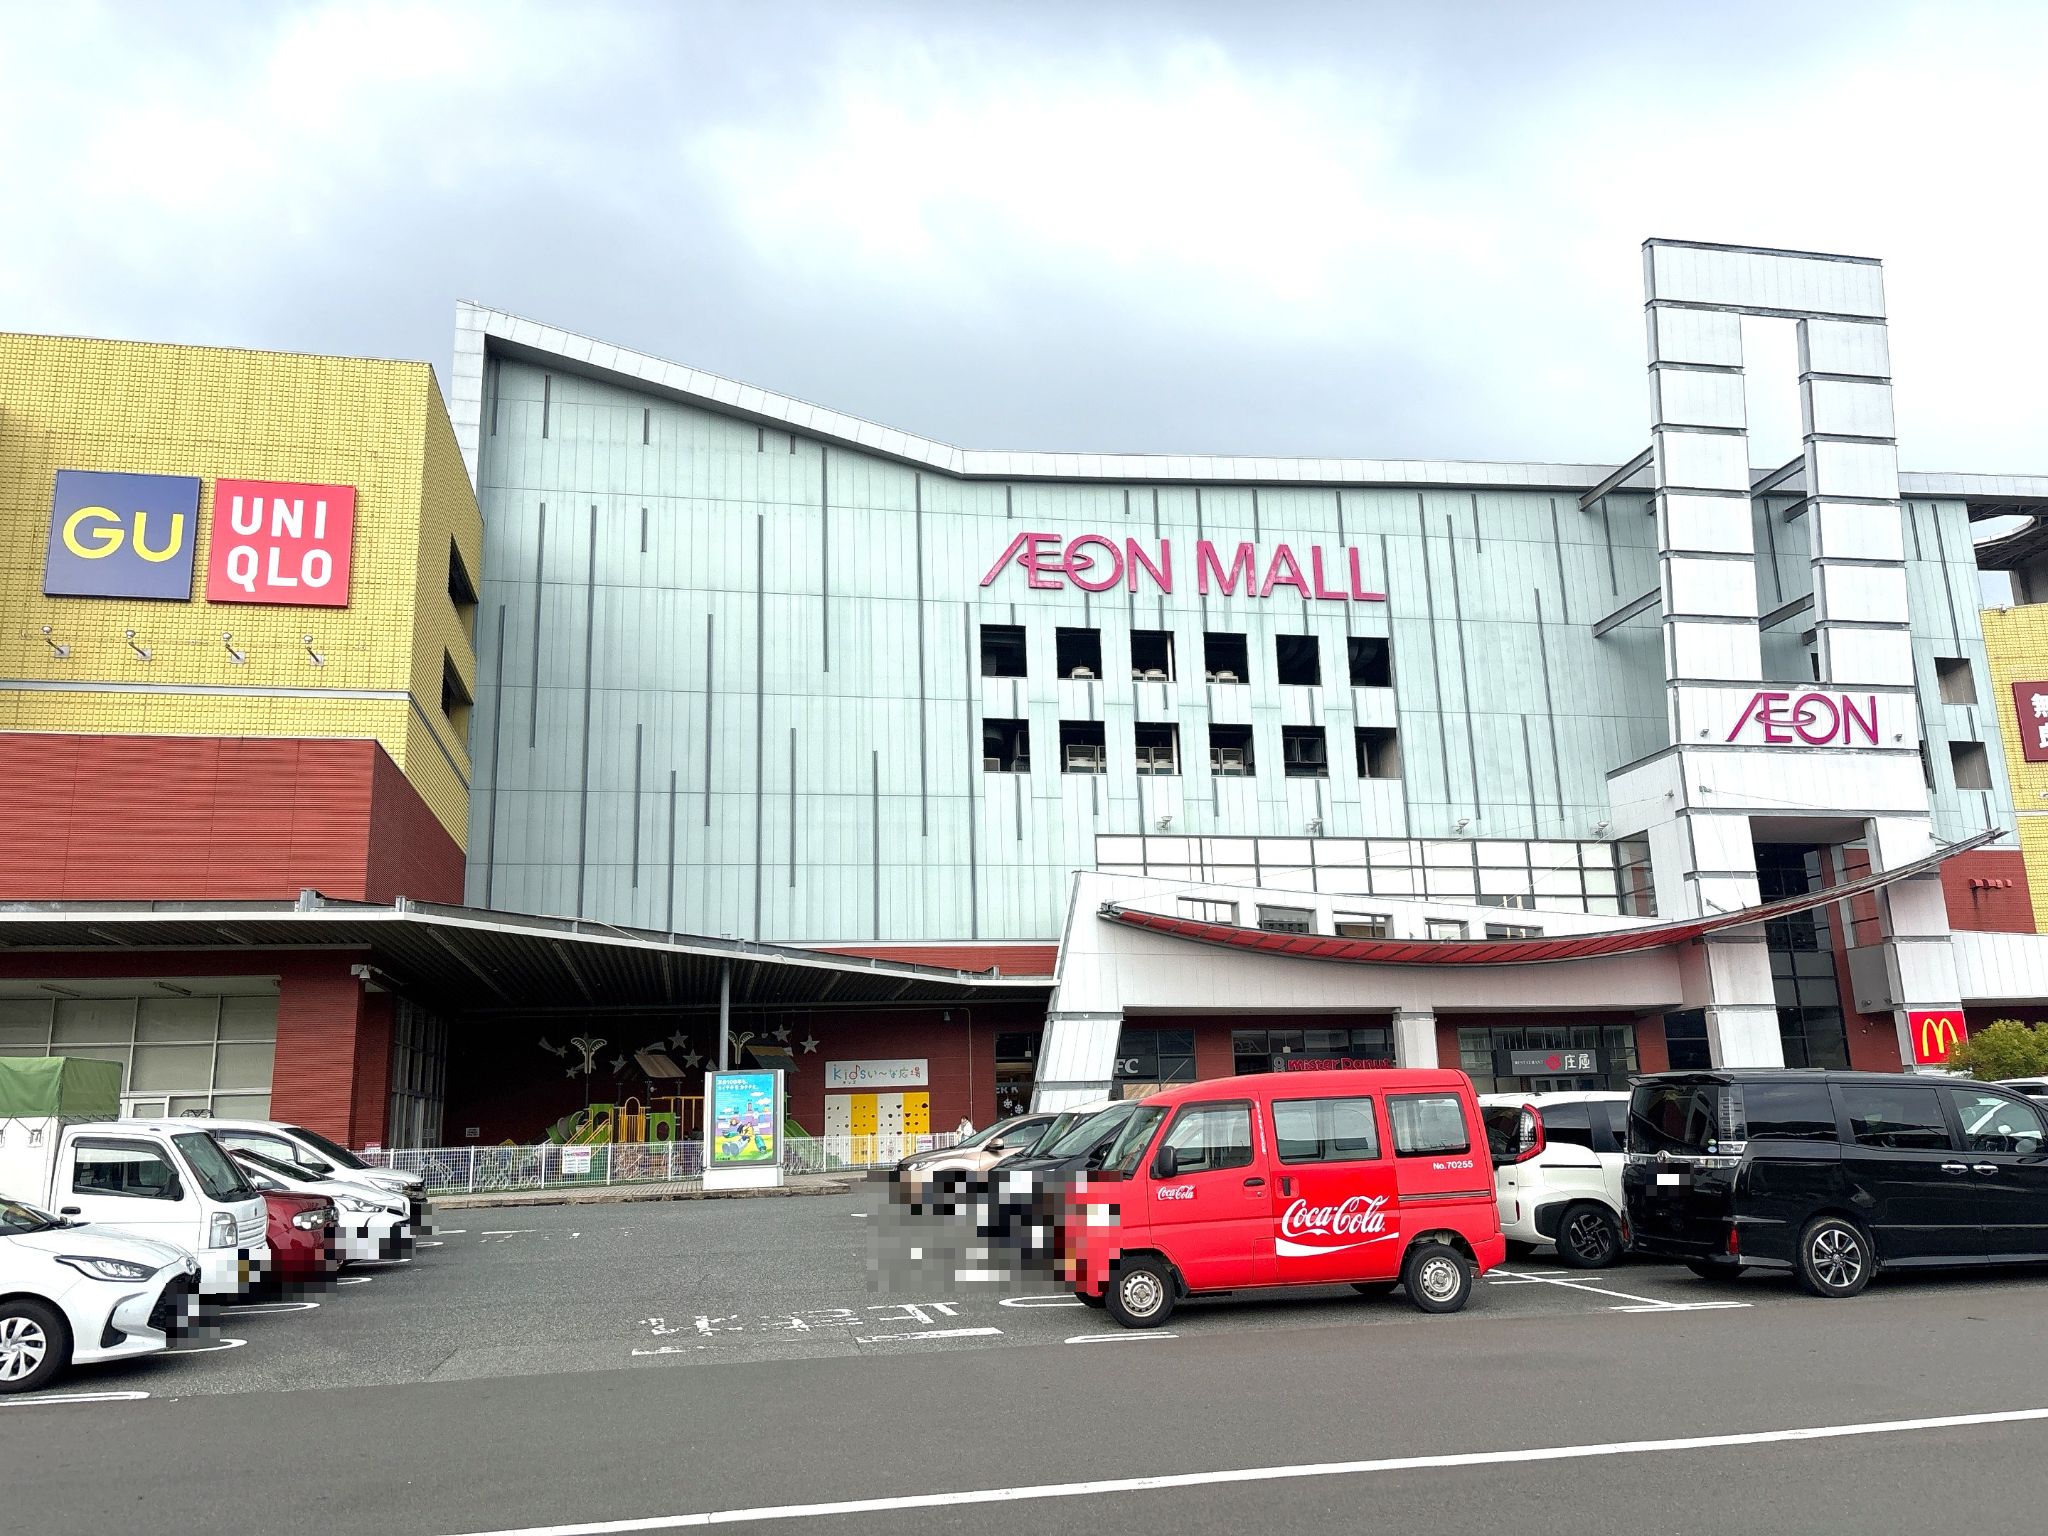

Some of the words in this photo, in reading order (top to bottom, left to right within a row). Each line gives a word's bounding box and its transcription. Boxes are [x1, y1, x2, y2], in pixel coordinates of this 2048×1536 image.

[231, 495, 327, 539] UNI
[62, 506, 184, 563] GU
[226, 545, 333, 592] QLO
[1197, 539, 1386, 601] MALL
[1114, 1058, 1139, 1074] FC
[1340, 1057, 1392, 1070] Donut
[1564, 1053, 1591, 1071] 庄屋
[1432, 1160, 1474, 1170] No.70255
[1157, 1185, 1196, 1200] Coca-Cola
[1281, 1195, 1390, 1237] Coca-Cola
